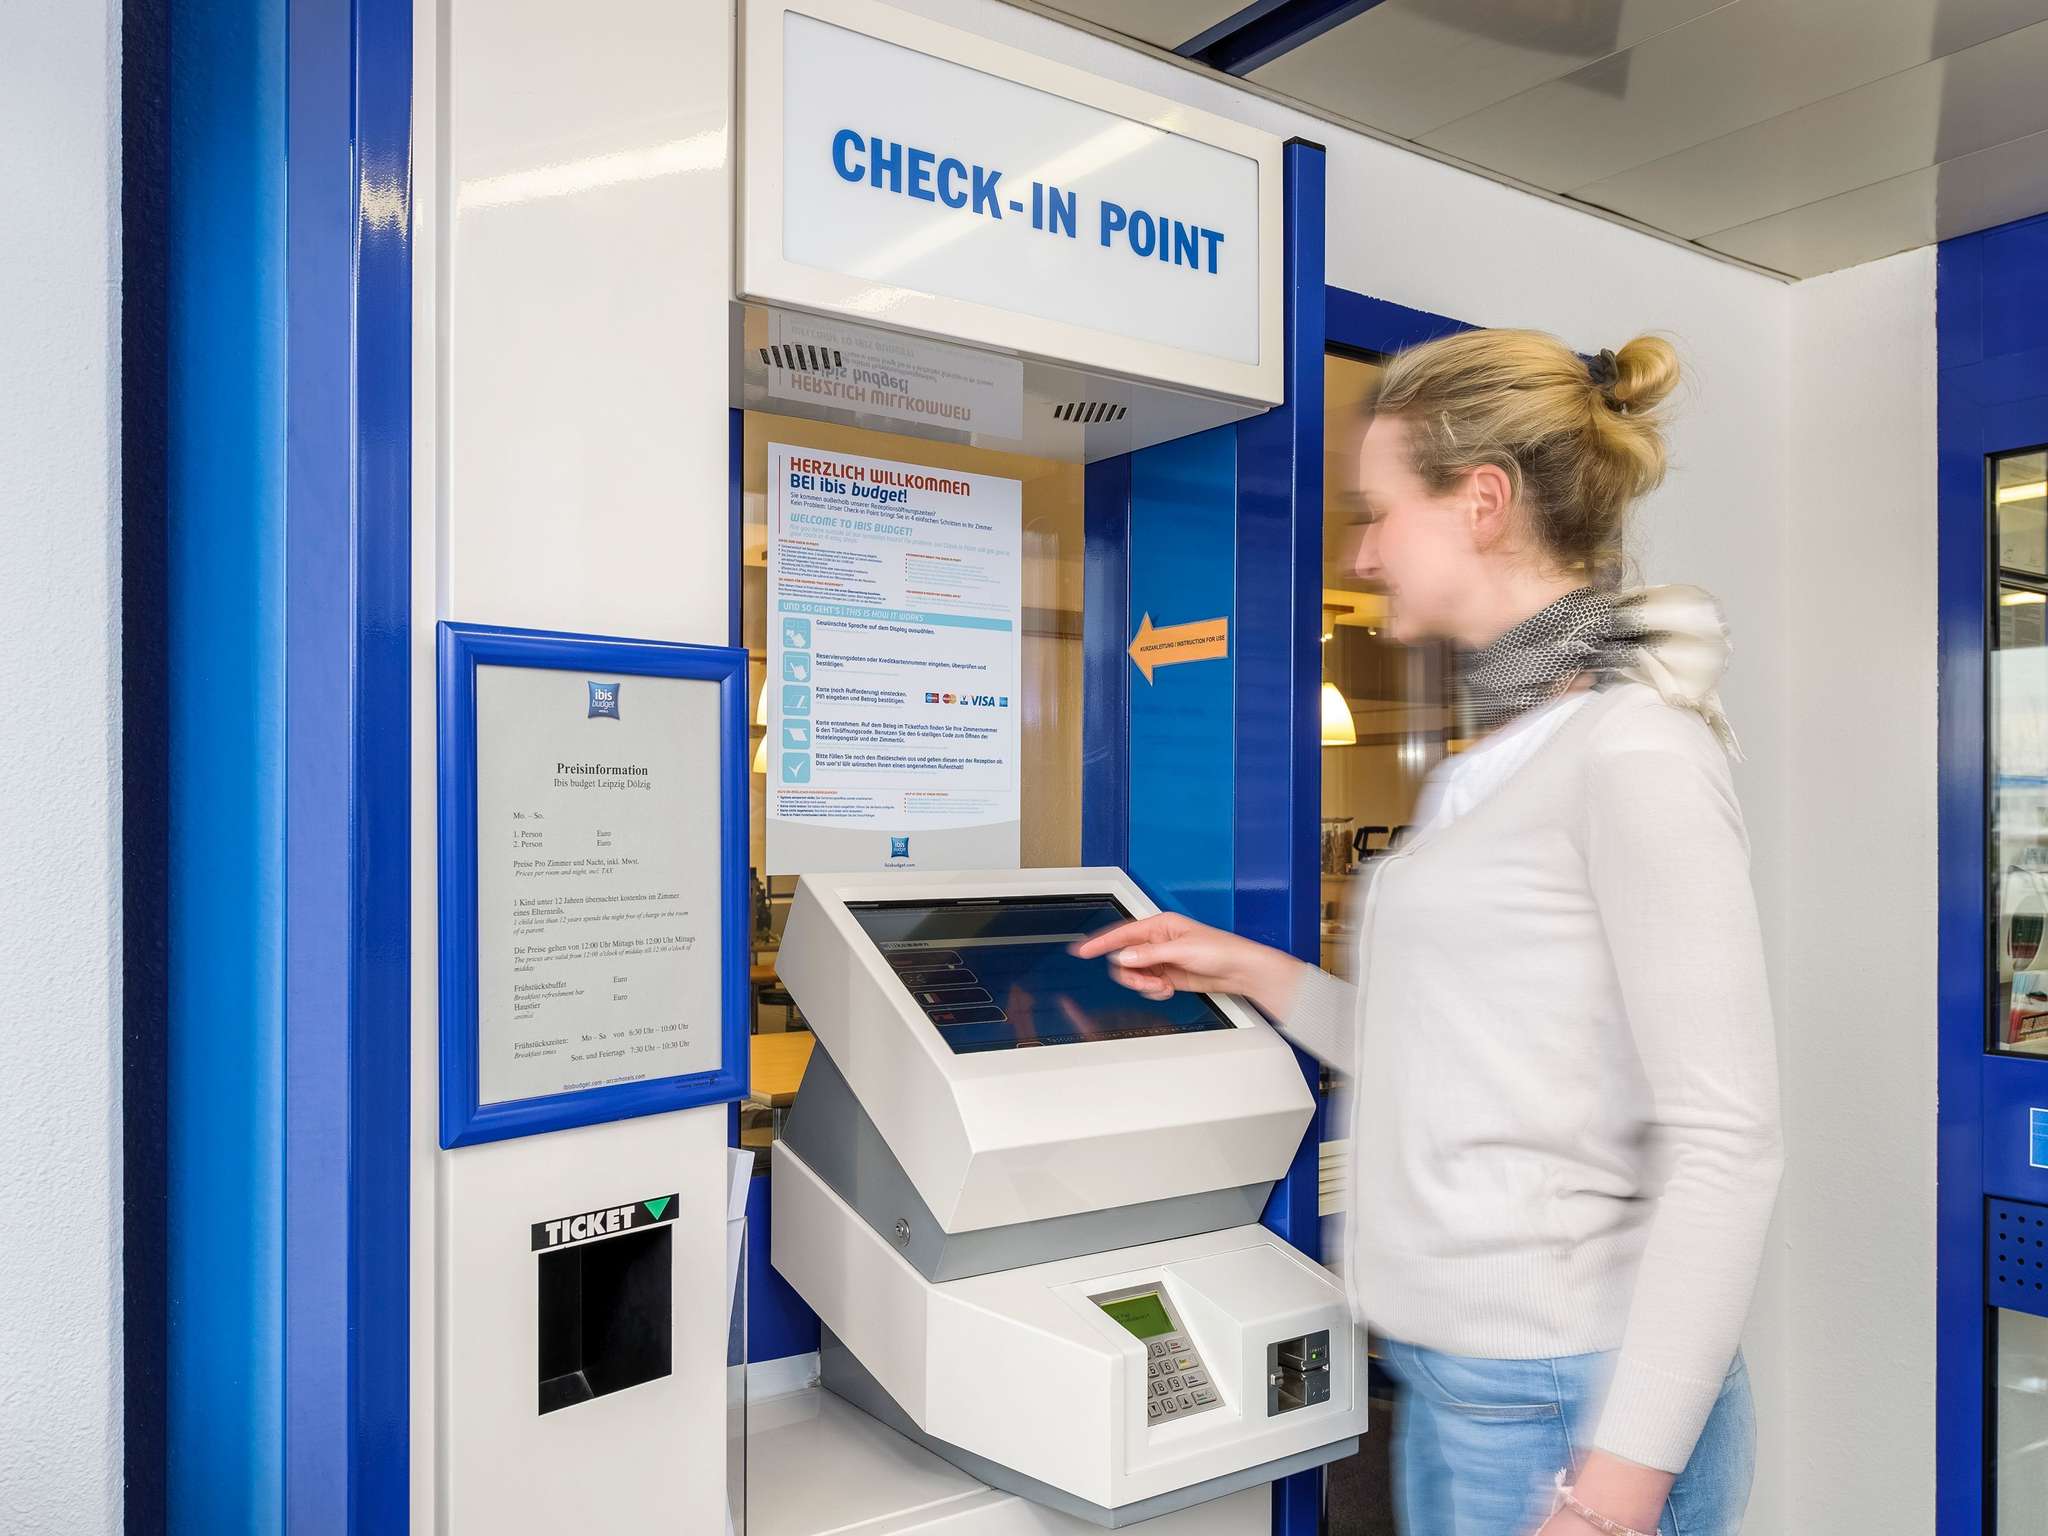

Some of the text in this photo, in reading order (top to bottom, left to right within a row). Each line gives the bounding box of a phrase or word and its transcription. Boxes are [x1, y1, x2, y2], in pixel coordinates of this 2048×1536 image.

[832, 129, 1224, 274] CHECK-IN POINT
[790, 457, 970, 496] HERZLICH WILLKOMMEN
[790, 473, 907, 507] BEI ibis budget!
[800, 493, 822, 502] kommen
[790, 499, 802, 507] Kein
[803, 501, 826, 510] Problem:
[827, 504, 842, 512] Unser
[843, 506, 865, 515] Check-in
[866, 509, 879, 517] Point
[880, 511, 895, 520] bringt
[915, 515, 939, 524] einfachen
[790, 513, 913, 536] WELCOME TO IBIS BUDGET!
[783, 602, 800, 611] UND
[801, 603, 811, 612] SO
[846, 608, 862, 617] THIS
[863, 609, 870, 618] IS
[871, 610, 887, 619] HOW
[888, 611, 896, 620] IT
[897, 612, 924, 622] WORKS
[816, 620, 847, 628] Gewünschte
[848, 622, 868, 631] Sprache
[889, 625, 908, 634] Display
[1176, 637, 1206, 647] INSTRUCTION
[1216, 634, 1225, 642] USE
[816, 653, 866, 663] Reservierungsdaten
[879, 657, 927, 666] Kreditkartennummer
[595, 689, 612, 700] ibis
[826, 694, 849, 702] eingeben
[591, 699, 615, 710] budget
[971, 696, 995, 706] VISA
[557, 763, 648, 776] Preisinformation
[553, 778, 651, 790] Ibis budget Leipzig Dölzig
[521, 830, 543, 838] Person
[521, 839, 612, 848] Person Euro
[513, 860, 533, 868] Preise
[547, 859, 572, 867] Zimmer
[514, 946, 526, 954] Die
[527, 945, 546, 954] Preise
[514, 1003, 541, 1012] Haustier
[581, 1034, 593, 1042] Mo
[599, 1032, 607, 1040] Sa
[570, 1053, 585, 1062] Son.
[585, 1051, 597, 1060] und
[599, 1048, 626, 1060] Feiertags
[546, 1206, 635, 1245] TICKET
[1155, 1344, 1163, 1354] 3
[1172, 1379, 1180, 1388] 9
